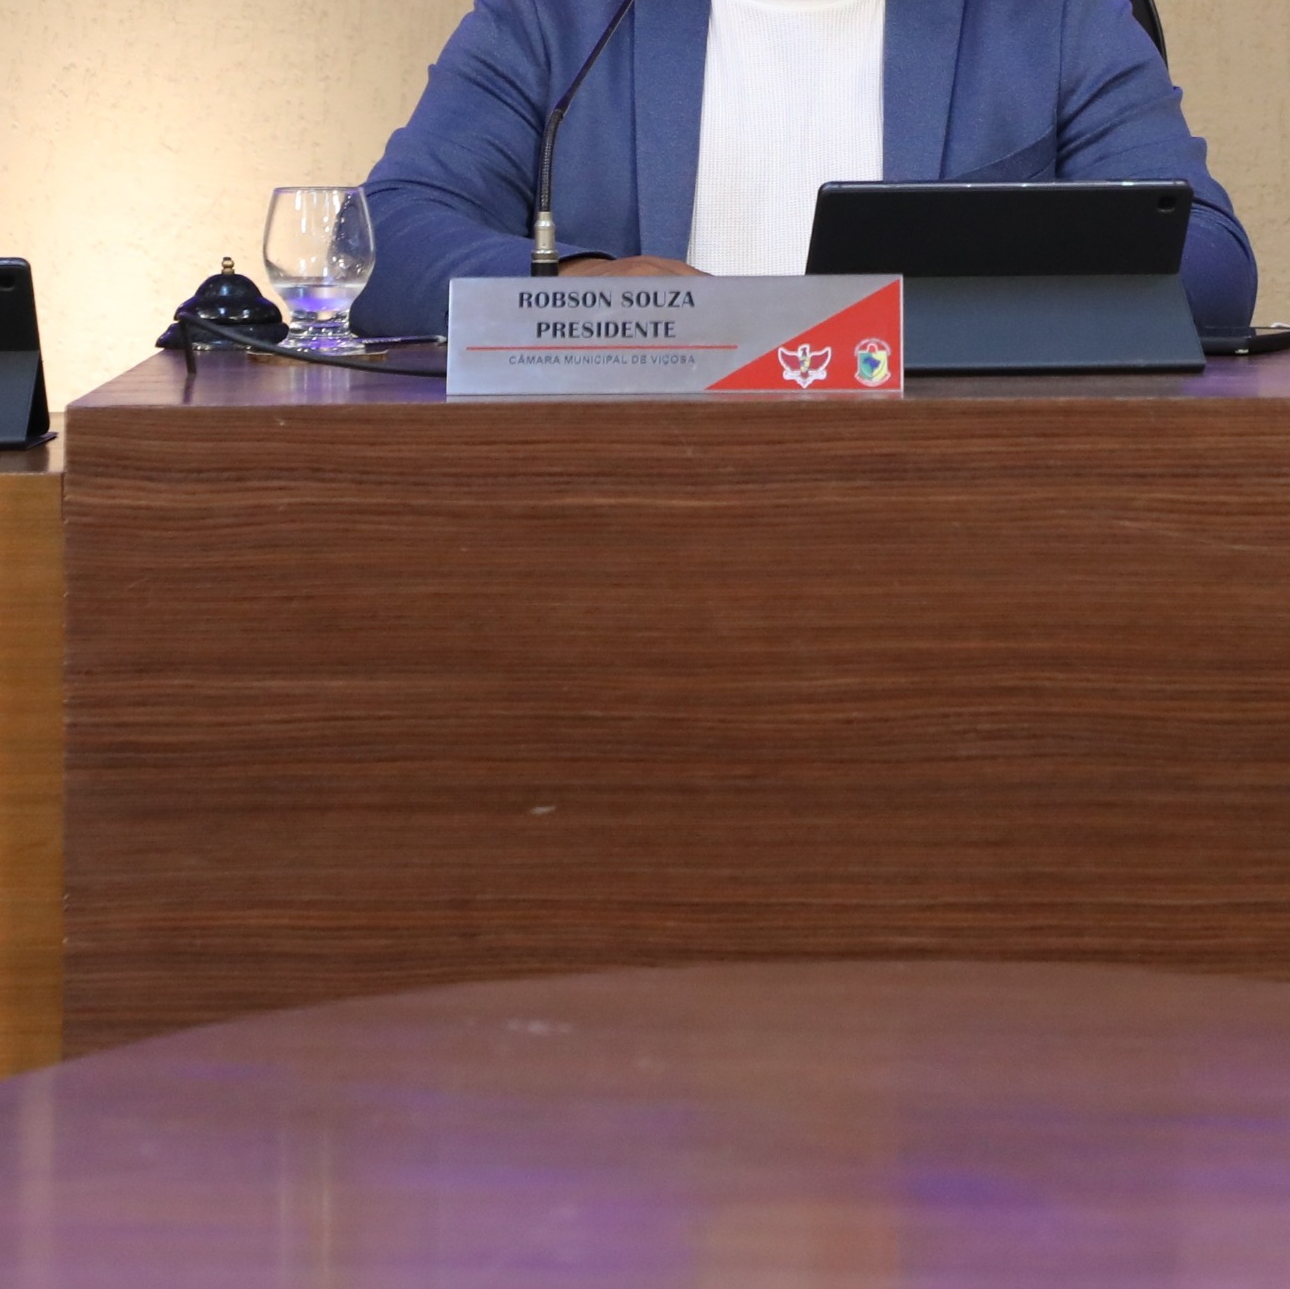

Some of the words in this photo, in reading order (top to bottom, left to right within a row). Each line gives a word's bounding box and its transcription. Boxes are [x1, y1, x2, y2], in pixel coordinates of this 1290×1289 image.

[518, 291, 612, 308] ROBSON
[621, 291, 695, 308] SOUZA
[536, 321, 676, 338] PRESIDENTE
[509, 353, 560, 365] CÂMARA
[564, 355, 627, 365] MUNICIPAL
[631, 355, 647, 364] DE
[651, 355, 695, 366] VIÇOSA
